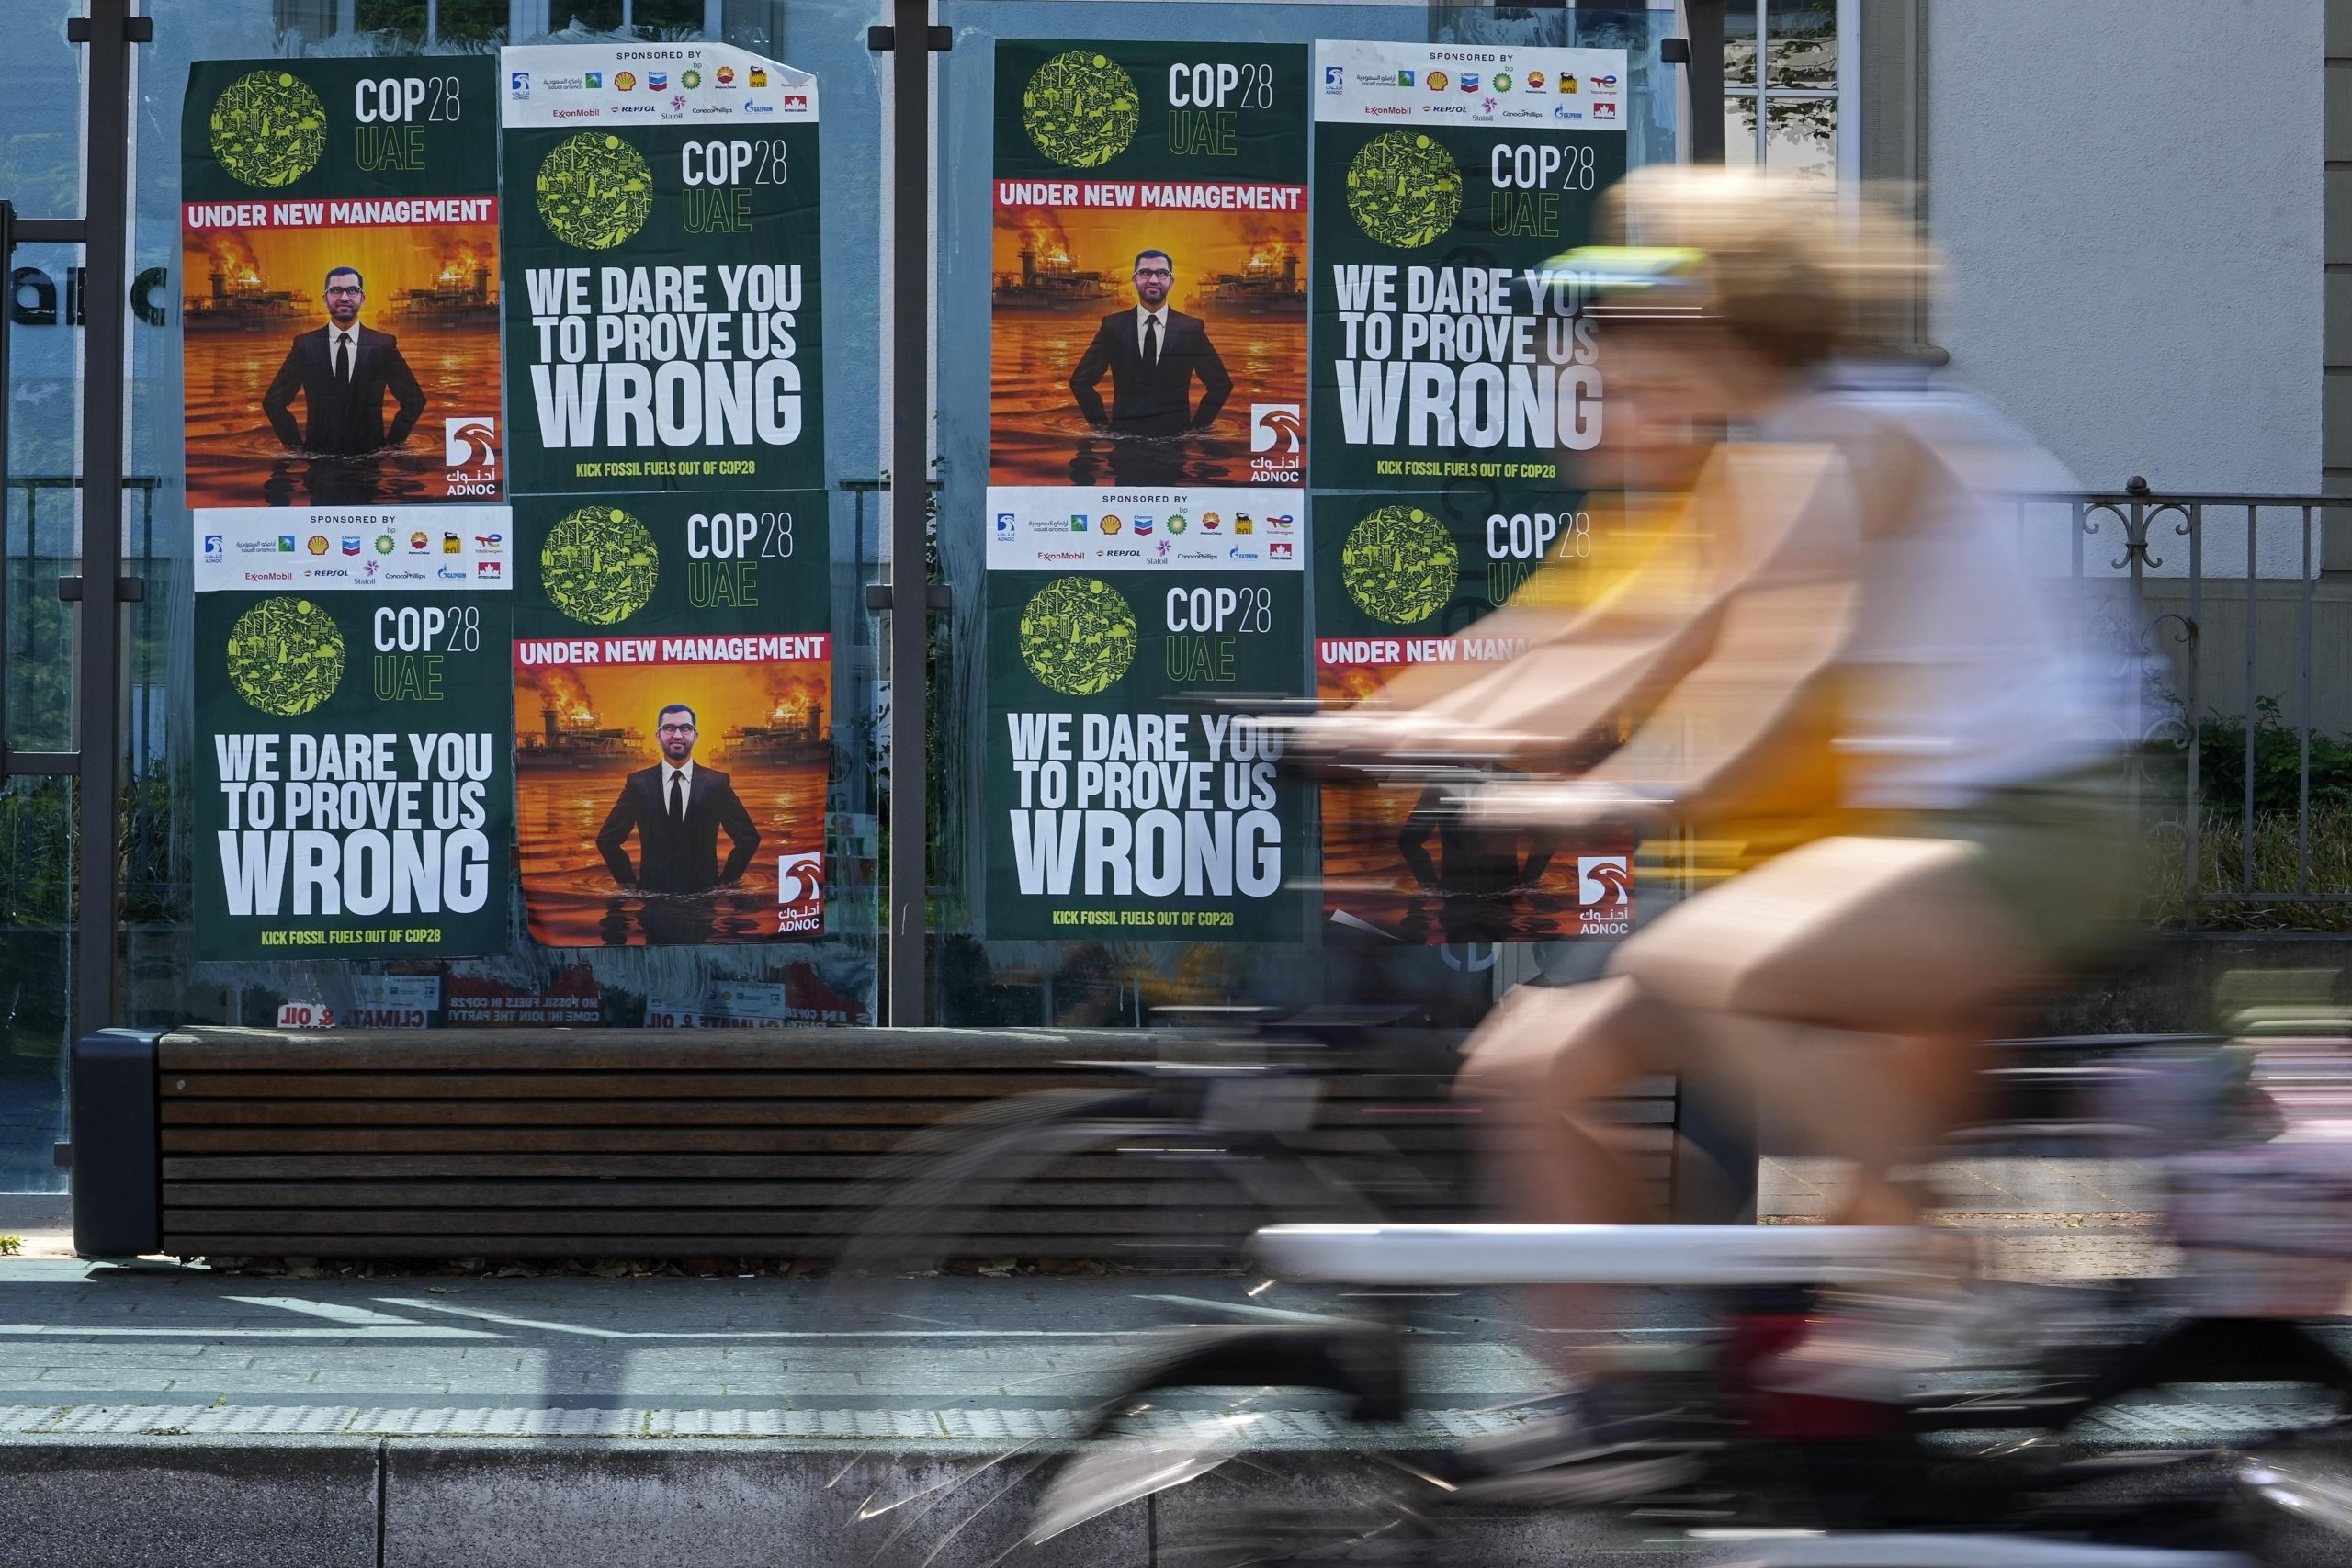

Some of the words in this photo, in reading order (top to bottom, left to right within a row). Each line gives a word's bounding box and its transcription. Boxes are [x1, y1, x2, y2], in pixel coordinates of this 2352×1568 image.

[1430, 52, 1495, 61] SPONSORED
[356, 76, 460, 122] COP28
[1169, 63, 1272, 108] COP28
[553, 109, 599, 118] ExxonMobil
[1169, 111, 1237, 155] UAE
[1365, 107, 1411, 115] ExxonMobil
[356, 126, 424, 170] UAE
[682, 140, 786, 186] COP28
[1492, 144, 1595, 190] COP28
[188, 204, 266, 228] UNDER
[273, 202, 323, 225] NEW
[330, 199, 491, 224] MANAGEMENT
[683, 188, 752, 233] UAE
[1000, 183, 1078, 206] UNDER
[1083, 185, 1135, 207] NEW
[1141, 185, 1301, 209] MANAGEMENT
[1491, 192, 1559, 237] UAE
[526, 267, 591, 315] WE
[601, 265, 706, 314] DARE
[718, 265, 801, 312] YOU
[1333, 264, 1396, 313] WE
[1408, 265, 1512, 314] DARE
[533, 316, 591, 363] TO
[597, 313, 731, 362] PROVE
[741, 312, 796, 359] US
[1340, 313, 1392, 360] TO
[1403, 314, 1536, 363] PROVE
[1548, 318, 1599, 365] US
[530, 359, 801, 448] WRONG
[1335, 359, 1603, 450] WRONG
[447, 484, 495, 496] ADNOC
[576, 463, 602, 477] KICK
[604, 463, 642, 477] FOSSIL
[644, 463, 676, 476] FUELS
[678, 462, 700, 475] OUT
[702, 461, 717, 475] OF
[719, 461, 755, 475] COP28
[1250, 471, 1299, 483] ADNOC
[1377, 460, 1403, 475] KICK
[1405, 461, 1442, 477] FOSSIL
[1444, 461, 1477, 477] FUELS
[1480, 462, 1502, 477] OUT
[1504, 463, 1518, 478] OF
[1521, 463, 1555, 479] COP28
[687, 512, 793, 558] COP28
[1038, 552, 1084, 561] ExxonMobil
[1487, 513, 1591, 559] COP28
[245, 573, 292, 581] ExxonMobil
[688, 561, 758, 607] UAE
[1488, 562, 1556, 607] UAE
[374, 606, 480, 652] COP28
[1167, 587, 1272, 633] COP28
[520, 641, 599, 664] UNDER
[605, 640, 655, 662] NEW
[662, 637, 824, 661] MANAGEMENT
[1167, 636, 1235, 682] UAE
[1322, 641, 1400, 664] UNDER
[1407, 639, 1456, 663] NEW
[375, 655, 443, 701] UAE
[214, 734, 279, 781] WE
[290, 733, 395, 781] DARE
[408, 733, 492, 781] YOU
[1008, 713, 1071, 761] WE
[1082, 713, 1189, 761] DARE
[1202, 713, 1283, 762] YOU
[220, 783, 274, 829] TO
[286, 782, 421, 829] PROVE
[432, 782, 485, 829] US
[1013, 761, 1066, 808] TO
[1078, 761, 1211, 809] PROVE
[1224, 762, 1276, 809] US
[218, 829, 489, 916] WRONG
[1010, 809, 1281, 897] WRONG
[261, 932, 287, 945] KICK
[289, 931, 327, 945] FOSSIL
[329, 931, 361, 944] FUELS
[364, 931, 386, 943] OUT
[389, 930, 402, 943] OF
[405, 930, 441, 942] COP28
[778, 919, 820, 933] ADNOC
[1053, 911, 1079, 925] KICK
[1081, 911, 1118, 925] FOSSIL
[1120, 911, 1153, 925] FUELS
[1157, 911, 1179, 925] OUT
[1182, 911, 1195, 926] OF
[1198, 911, 1233, 926] COP28
[1581, 923, 1628, 935] ADNOC
